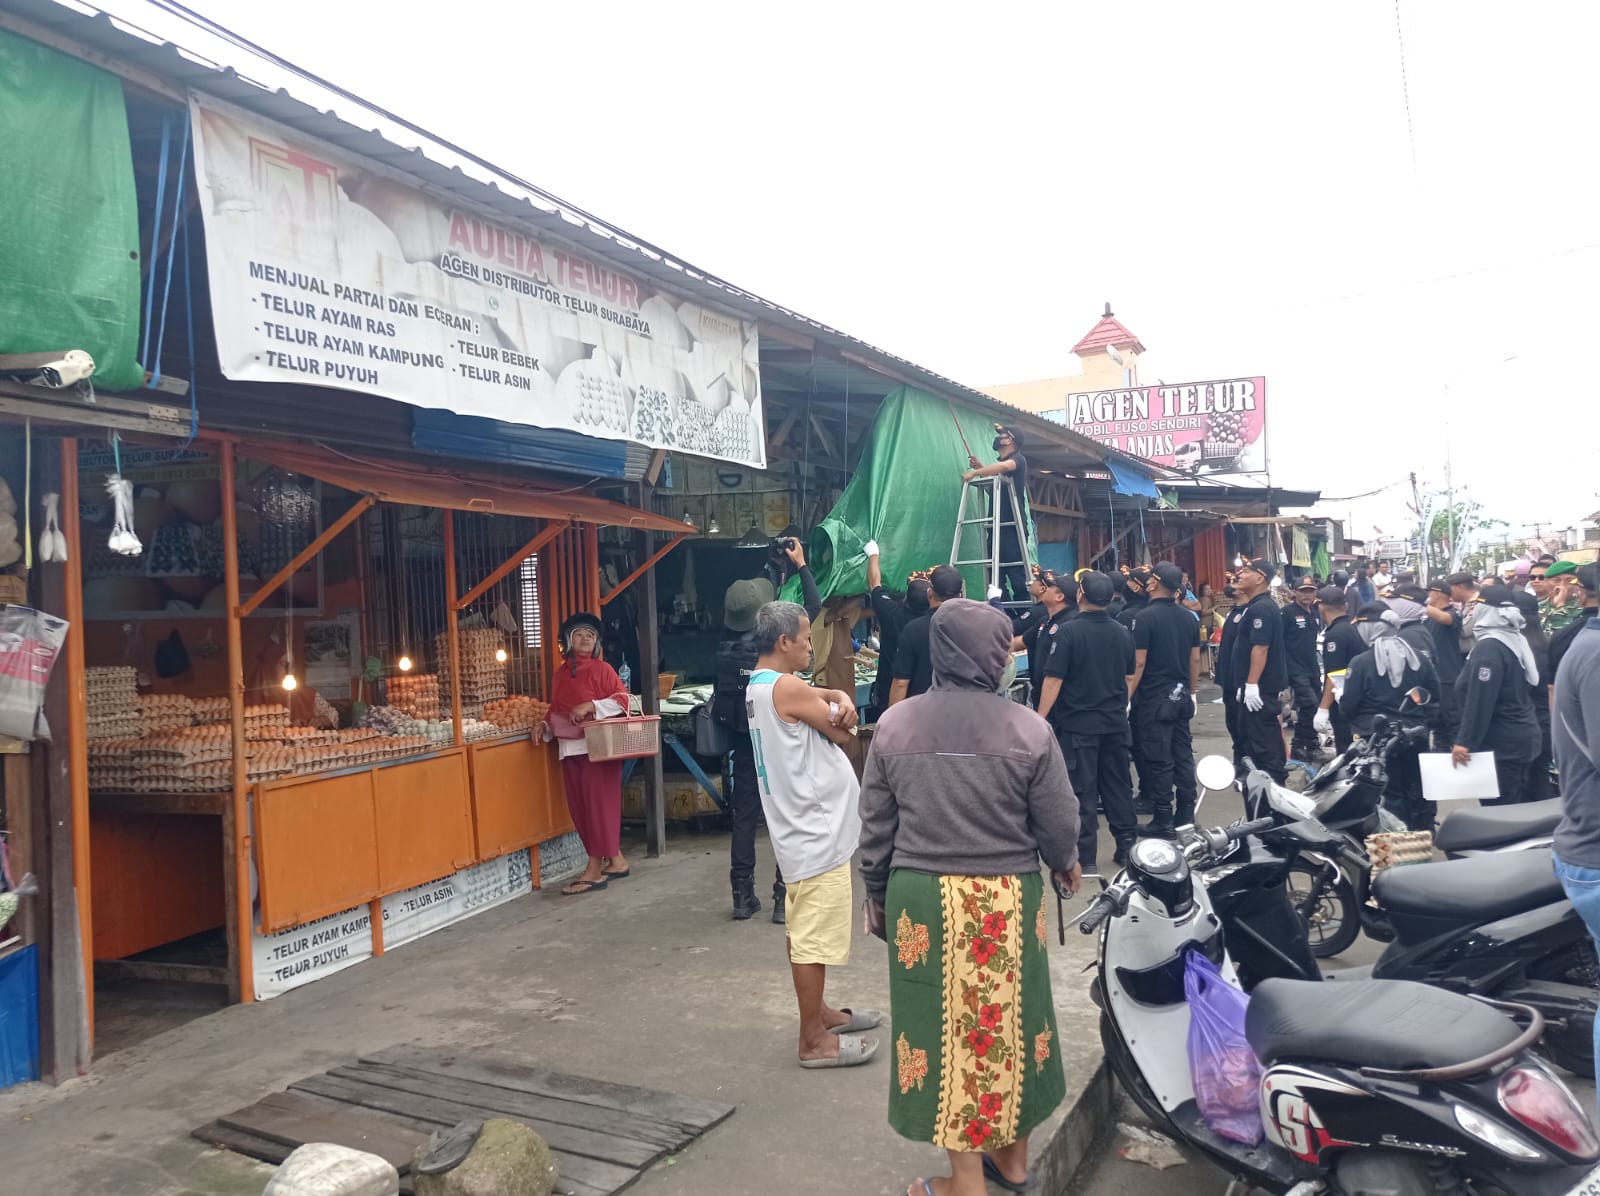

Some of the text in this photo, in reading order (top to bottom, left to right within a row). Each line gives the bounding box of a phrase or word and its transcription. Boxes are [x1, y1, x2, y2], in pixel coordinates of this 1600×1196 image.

[449, 212, 640, 311] AULIA TELUR
[249, 261, 330, 296] MENJUAL
[334, 283, 384, 310] PARTAI
[389, 298, 419, 318] DAN
[424, 305, 471, 332] ECERAN
[261, 293, 316, 320] TELUR
[321, 308, 362, 331] AYAM
[366, 318, 396, 337] RAS
[442, 255, 650, 334] AGEN DISTRIBUTOR TELUR SURABAYA
[264, 321, 318, 348] TELUR
[323, 335, 364, 357] AYAM
[368, 344, 444, 369] KAMPUNG
[457, 340, 499, 362] TELUR
[502, 350, 540, 371] BEBEK
[266, 350, 320, 375] TELUR
[325, 361, 379, 385] PUYUH
[459, 363, 502, 385] TELUR
[504, 373, 531, 391] ASIN
[1074, 381, 1256, 425] AGEN TELUR
[1114, 420, 1148, 433] FUSO
[1150, 416, 1201, 431] SENDIRI
[1127, 433, 1174, 460] ANJAS
[404, 896, 433, 912] TELUR
[434, 885, 453, 902] ASIN
[273, 938, 309, 960] TELUR
[312, 926, 340, 947] AYAM
[342, 909, 390, 936] KAMPG
[275, 960, 310, 981] TELUR
[313, 943, 349, 968] PUYUH
